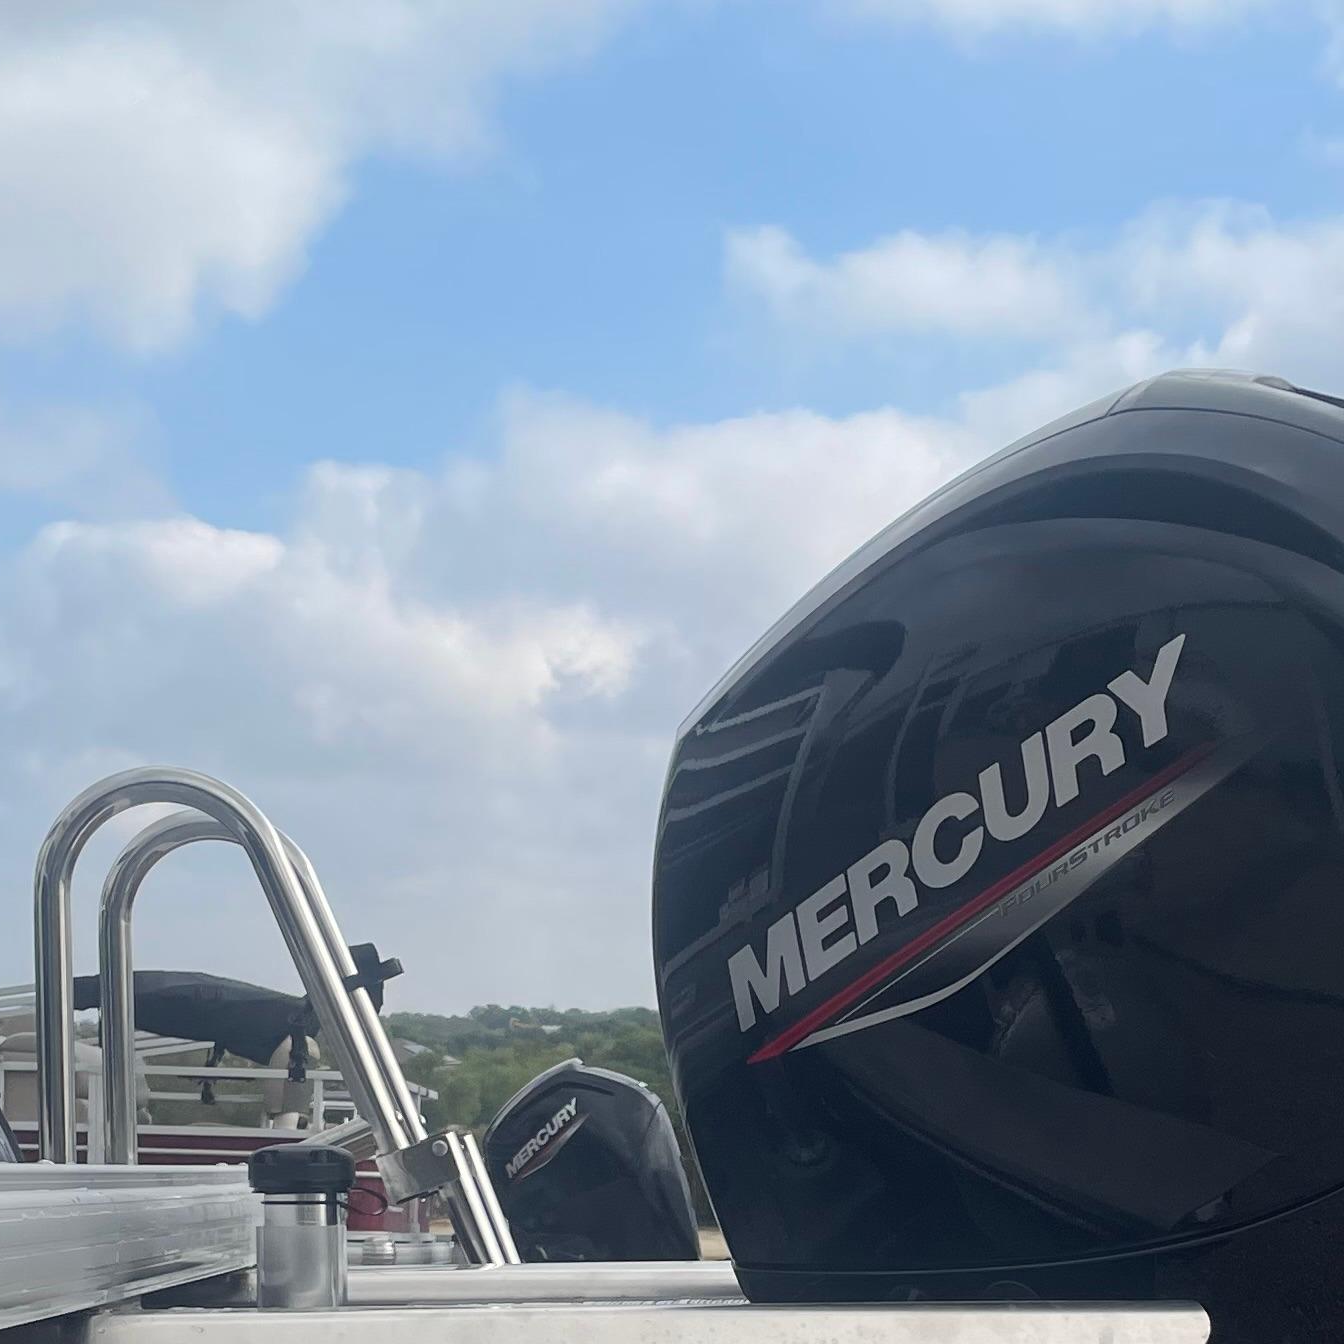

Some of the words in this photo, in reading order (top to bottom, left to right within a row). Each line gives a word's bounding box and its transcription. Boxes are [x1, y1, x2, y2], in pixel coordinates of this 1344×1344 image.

[727, 633, 1186, 1033] MERCURY
[1000, 786, 1176, 918] FOURSTROKE
[505, 1097, 578, 1179] MERCURY
